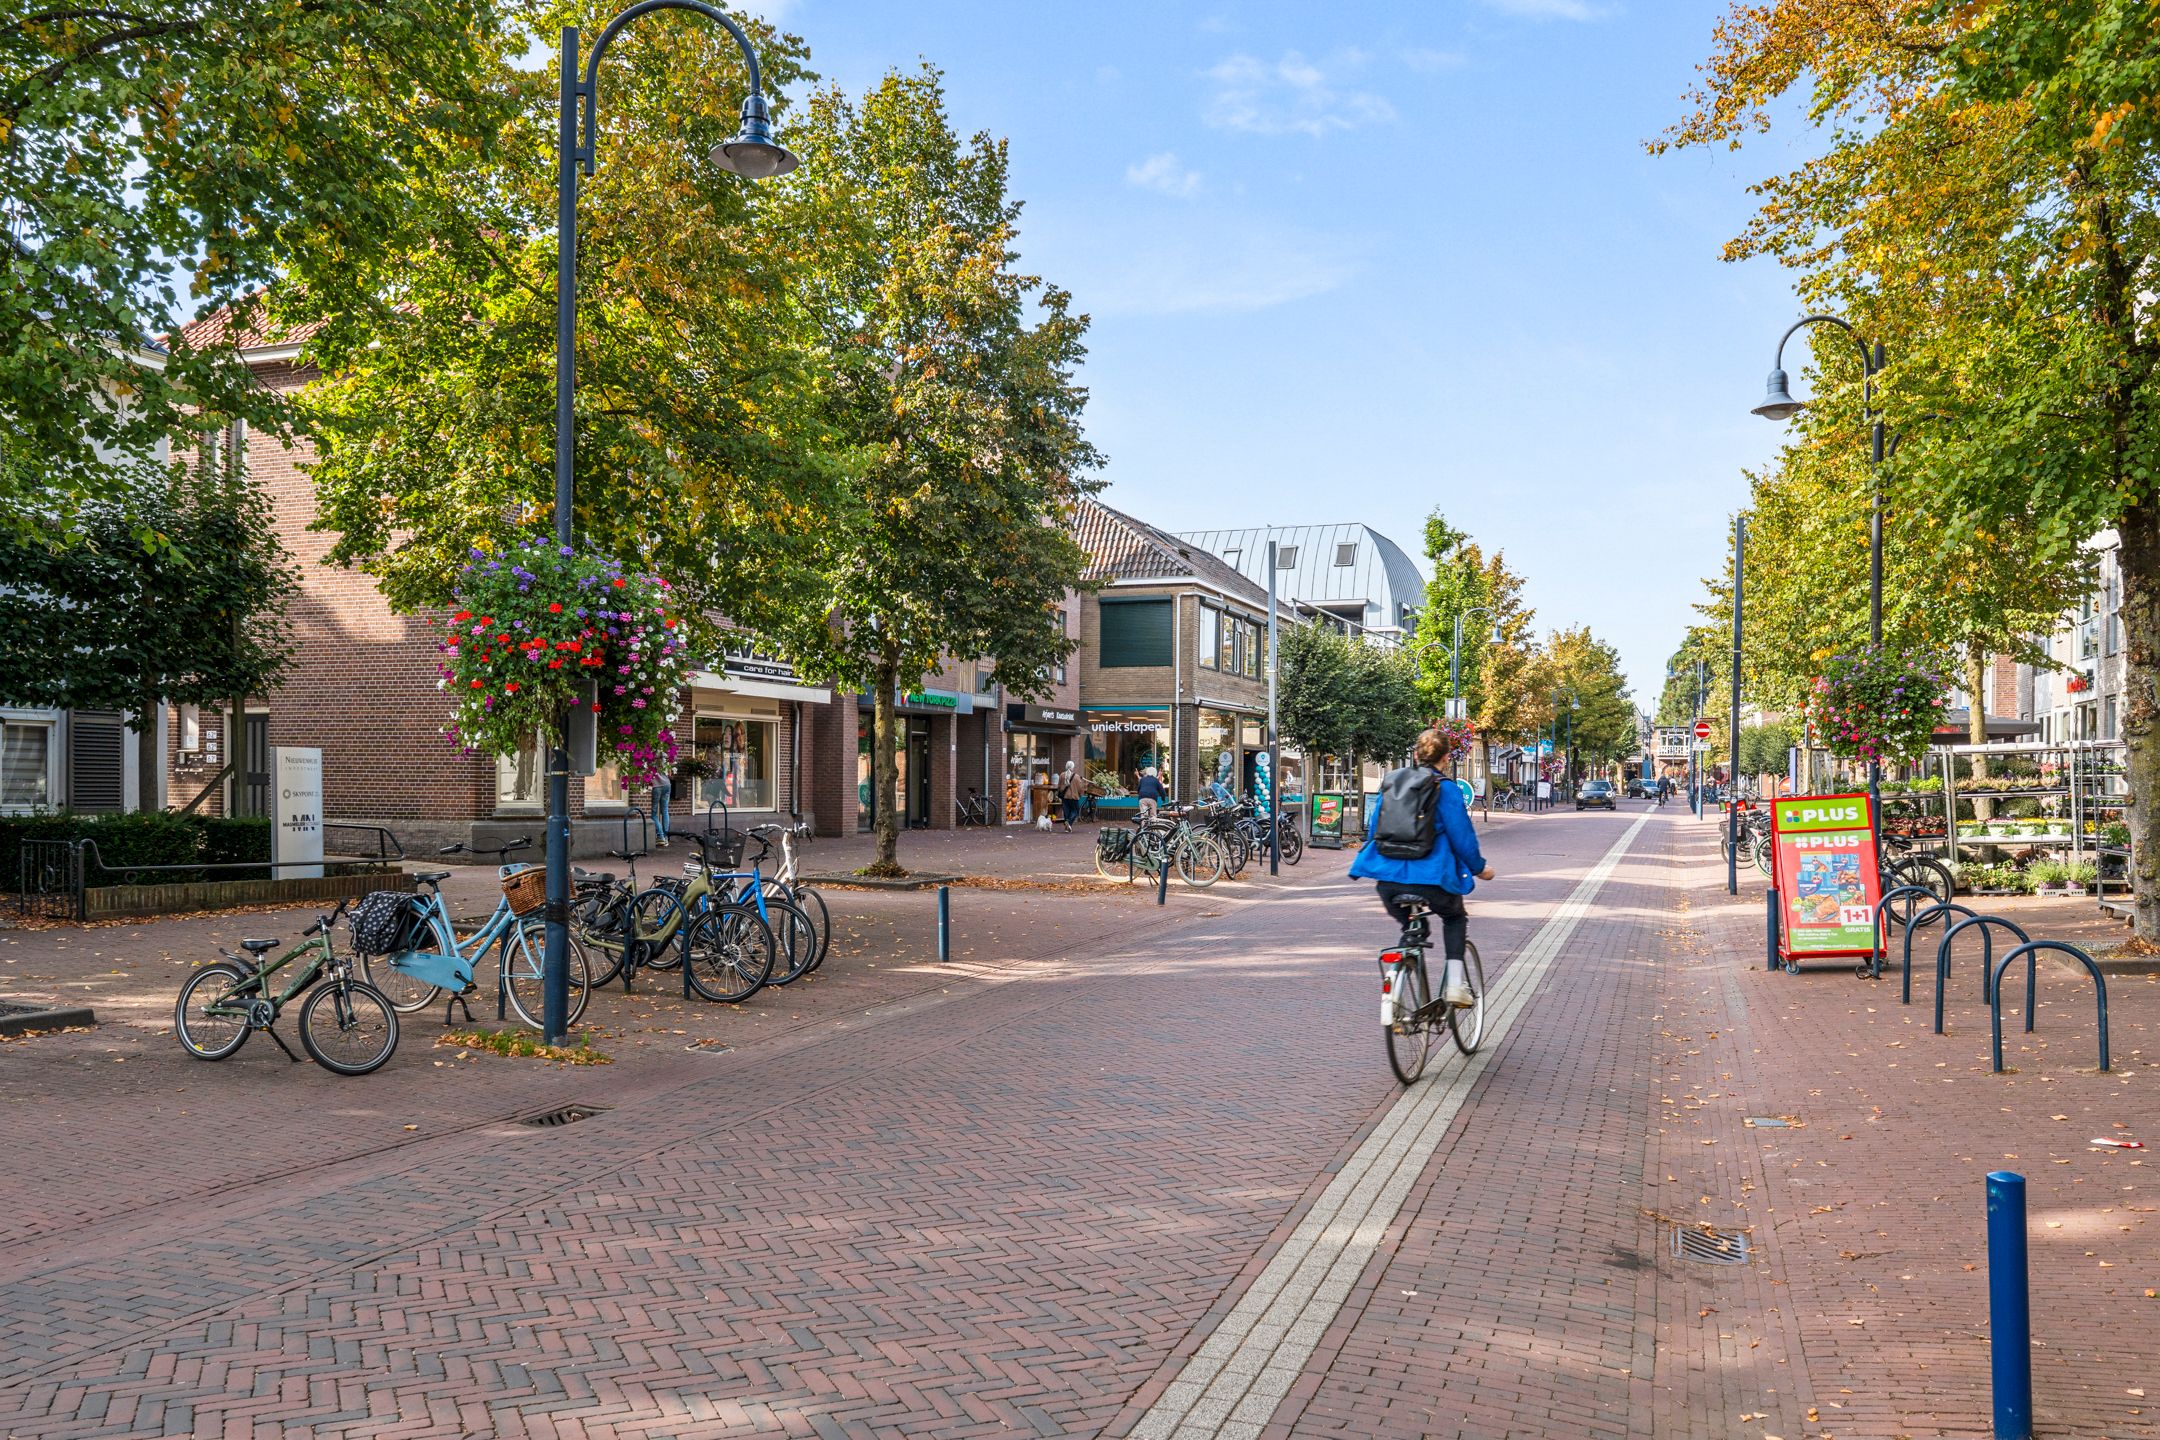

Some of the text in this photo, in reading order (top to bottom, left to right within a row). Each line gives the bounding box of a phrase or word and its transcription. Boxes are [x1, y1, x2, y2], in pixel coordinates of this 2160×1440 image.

[743, 665, 793, 676] care for hair
[910, 693, 925, 703] NEW
[1091, 721, 1162, 734] uniek slapen
[1802, 807, 1859, 822] PLUS
[1810, 835, 1860, 848] PLUS
[1844, 909, 1870, 922] 1+1
